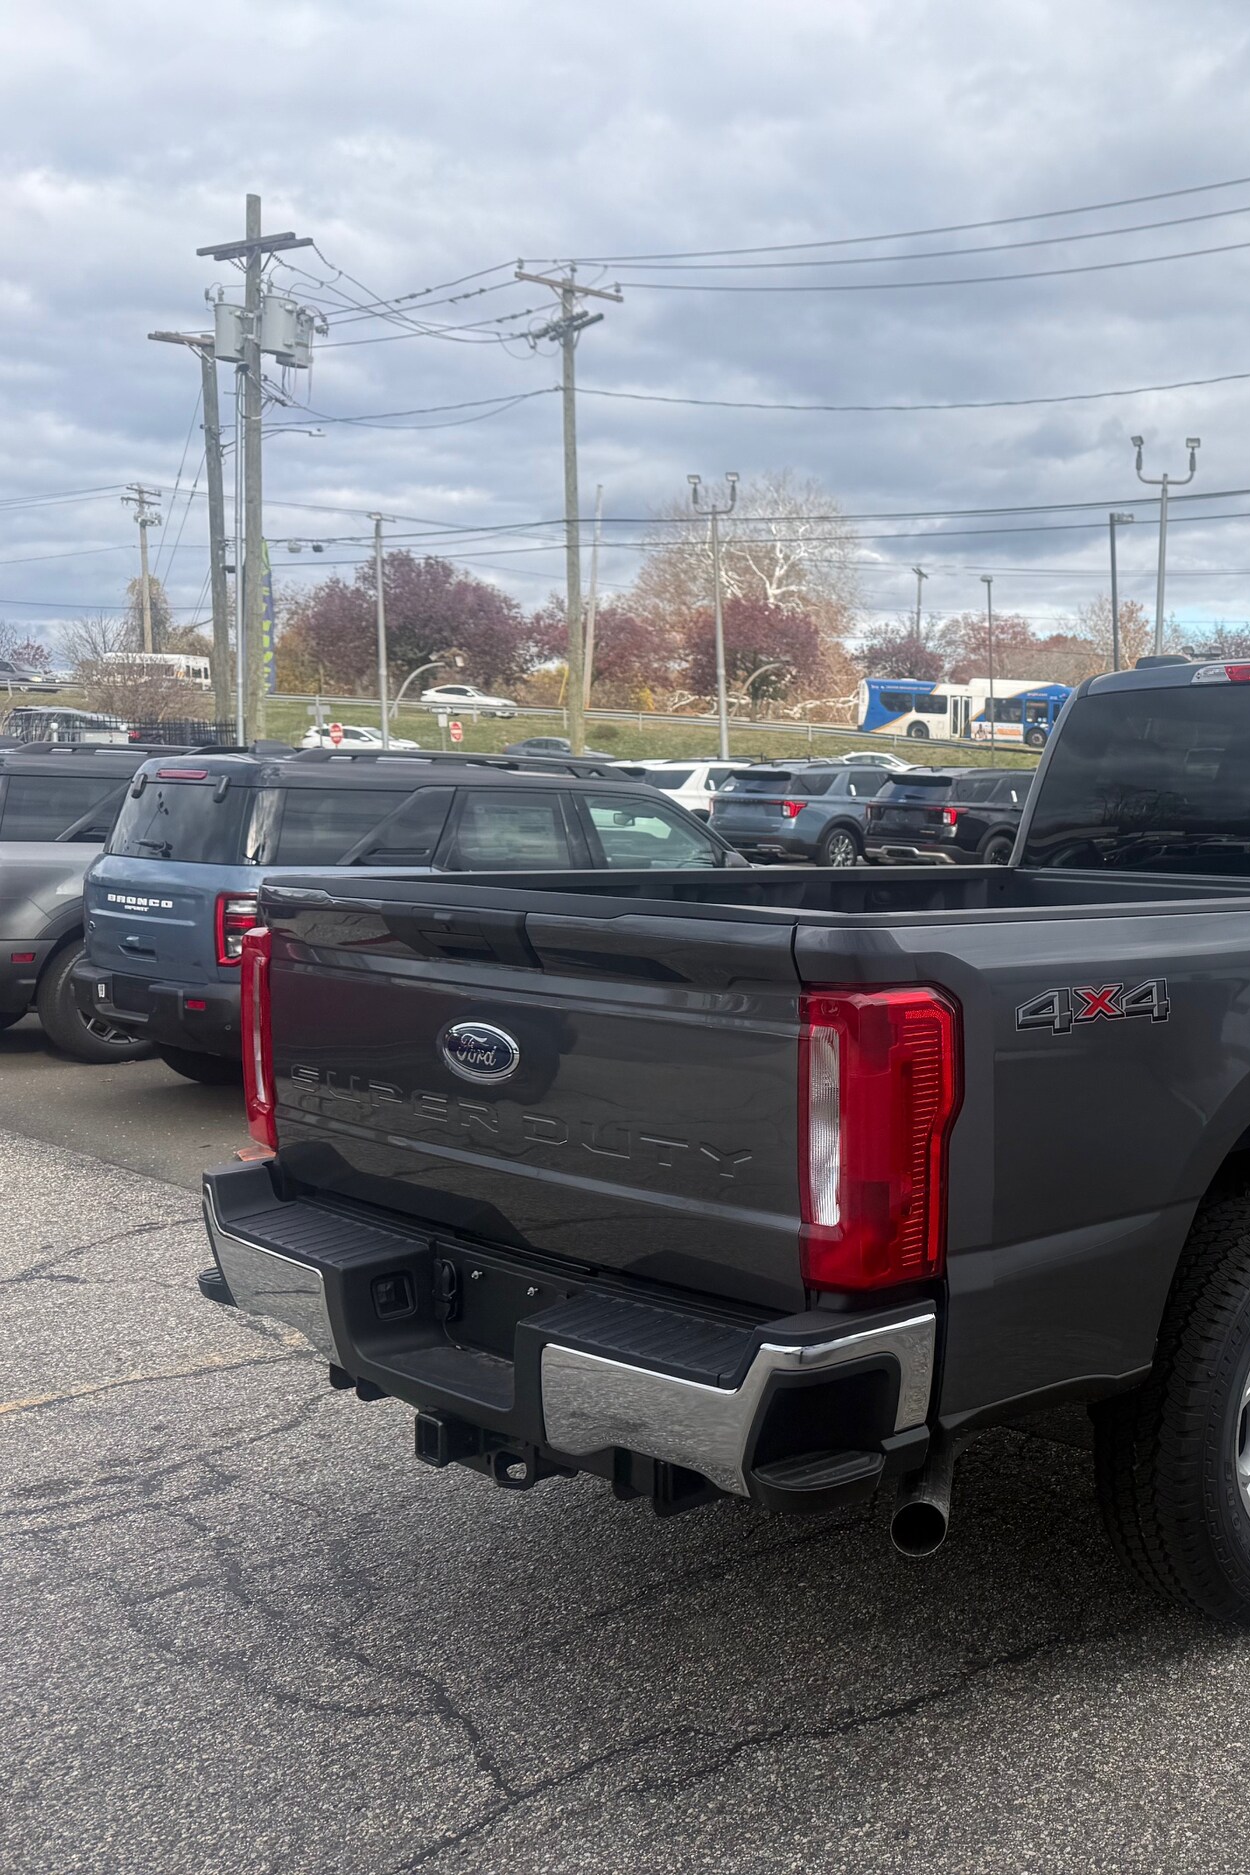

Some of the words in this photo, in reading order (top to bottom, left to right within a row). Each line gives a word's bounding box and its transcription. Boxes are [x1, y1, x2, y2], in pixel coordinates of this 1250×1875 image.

[107, 893, 173, 908] BRONCO
[124, 904, 149, 912] SPORT
[456, 1033, 498, 1066] Ford
[291, 1063, 499, 1133] SUPER
[522, 1111, 753, 1178] DUTY
